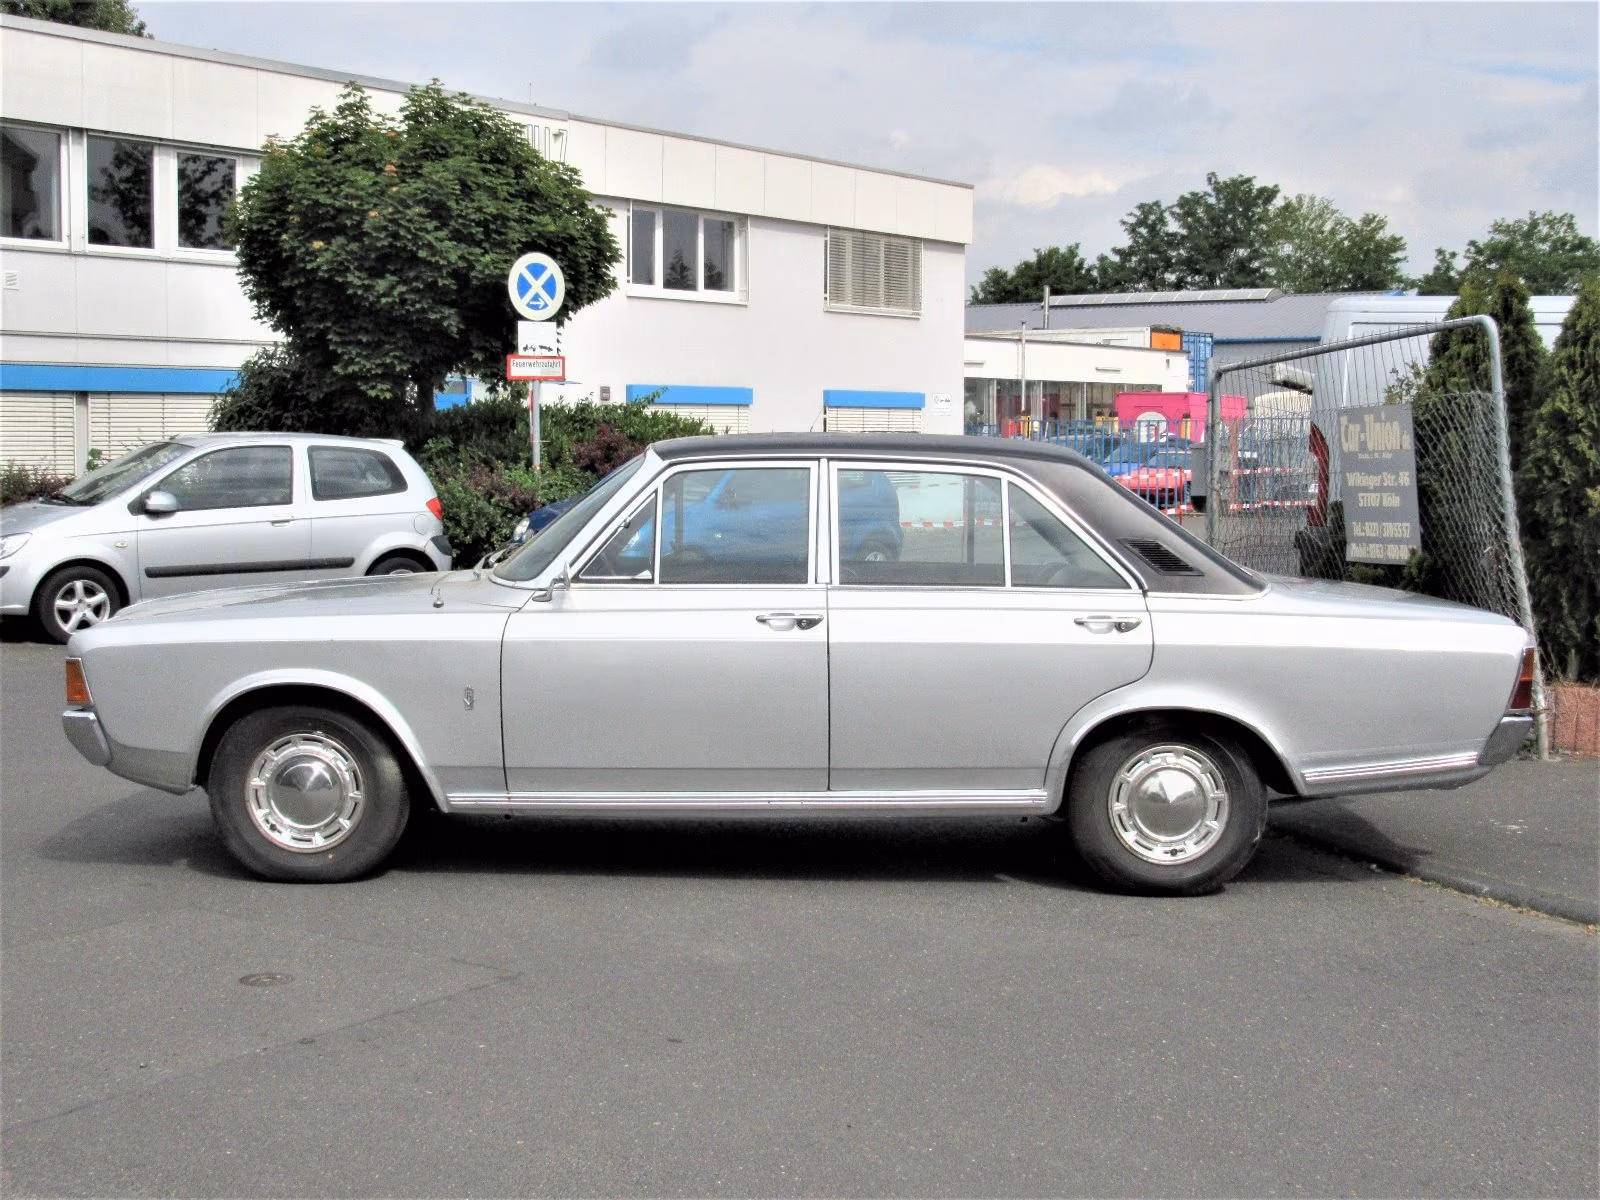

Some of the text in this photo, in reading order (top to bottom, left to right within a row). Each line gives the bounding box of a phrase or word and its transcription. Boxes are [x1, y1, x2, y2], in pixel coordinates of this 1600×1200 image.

[512, 360, 560, 368] Feuerwehrzufahrt
[1346, 472, 1381, 488] Wikinger
[1382, 472, 1398, 487] Str.
